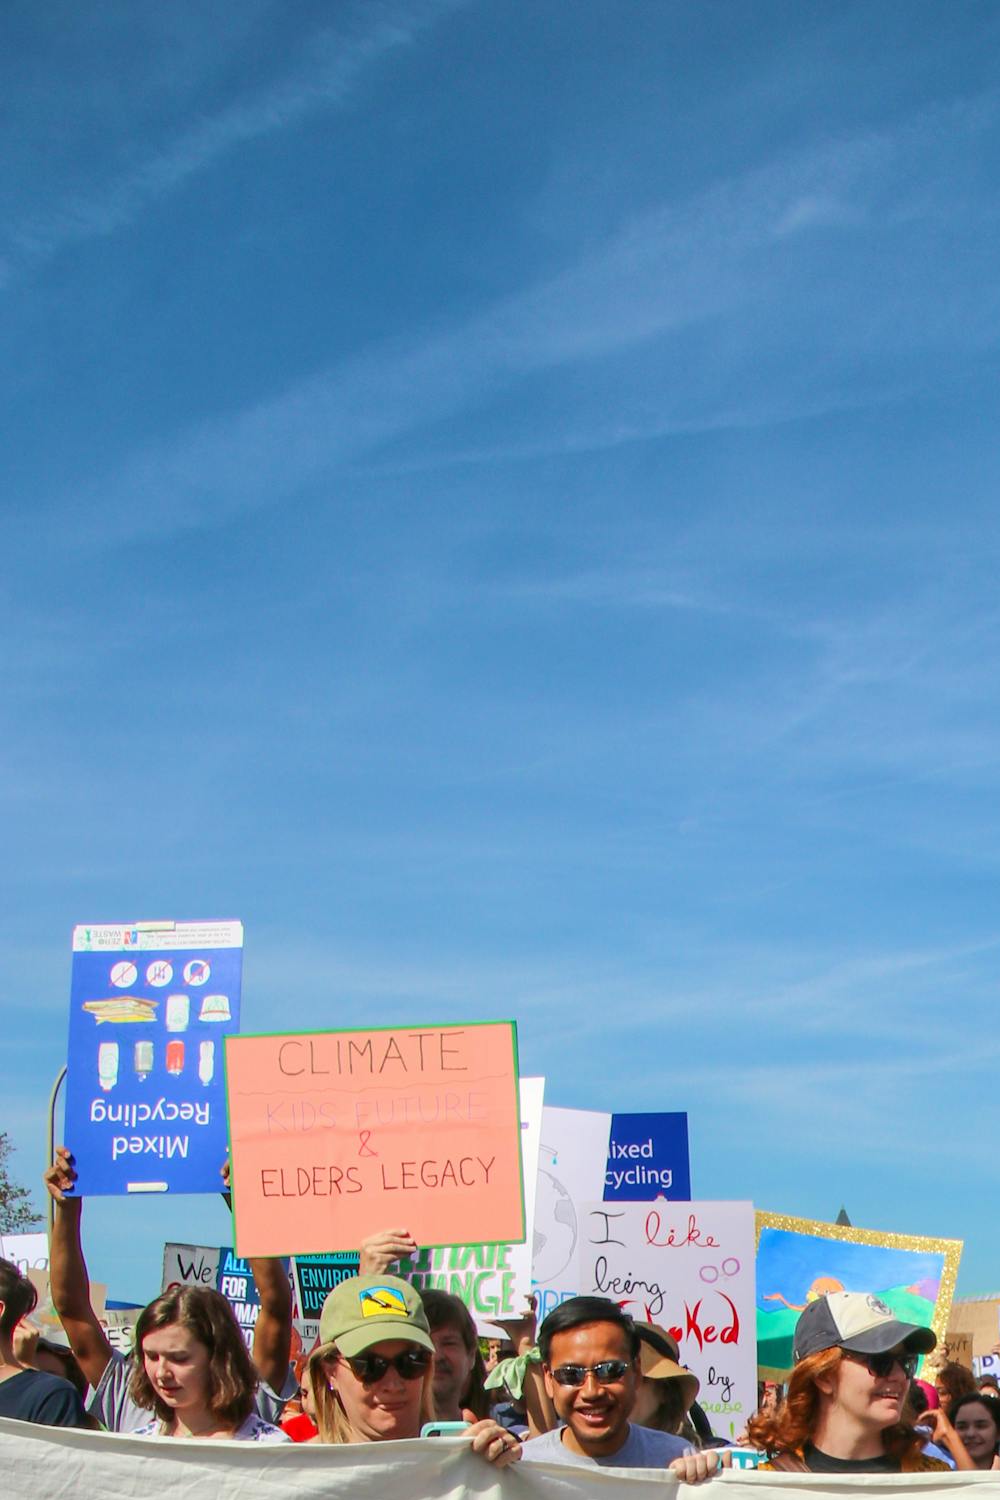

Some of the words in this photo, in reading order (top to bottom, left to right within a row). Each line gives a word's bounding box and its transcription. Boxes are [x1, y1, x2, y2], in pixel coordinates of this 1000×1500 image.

[278, 1031, 468, 1076] CLIMATE
[90, 1096, 210, 1128] Recycling
[266, 1100, 337, 1133] KIDS
[355, 1092, 490, 1128] FUTURE
[112, 1135, 189, 1161] Mixed
[358, 1130, 379, 1157] &
[607, 1138, 654, 1159] ixed
[261, 1165, 363, 1198] ELDERS
[382, 1156, 496, 1191] LEGACY
[604, 1165, 673, 1190] cycling
[589, 1210, 627, 1248] I
[646, 1210, 721, 1248] like
[221, 1276, 247, 1299] FOR
[304, 1290, 329, 1310] JUS
[592, 1255, 667, 1316] being
[708, 1366, 735, 1403] by
